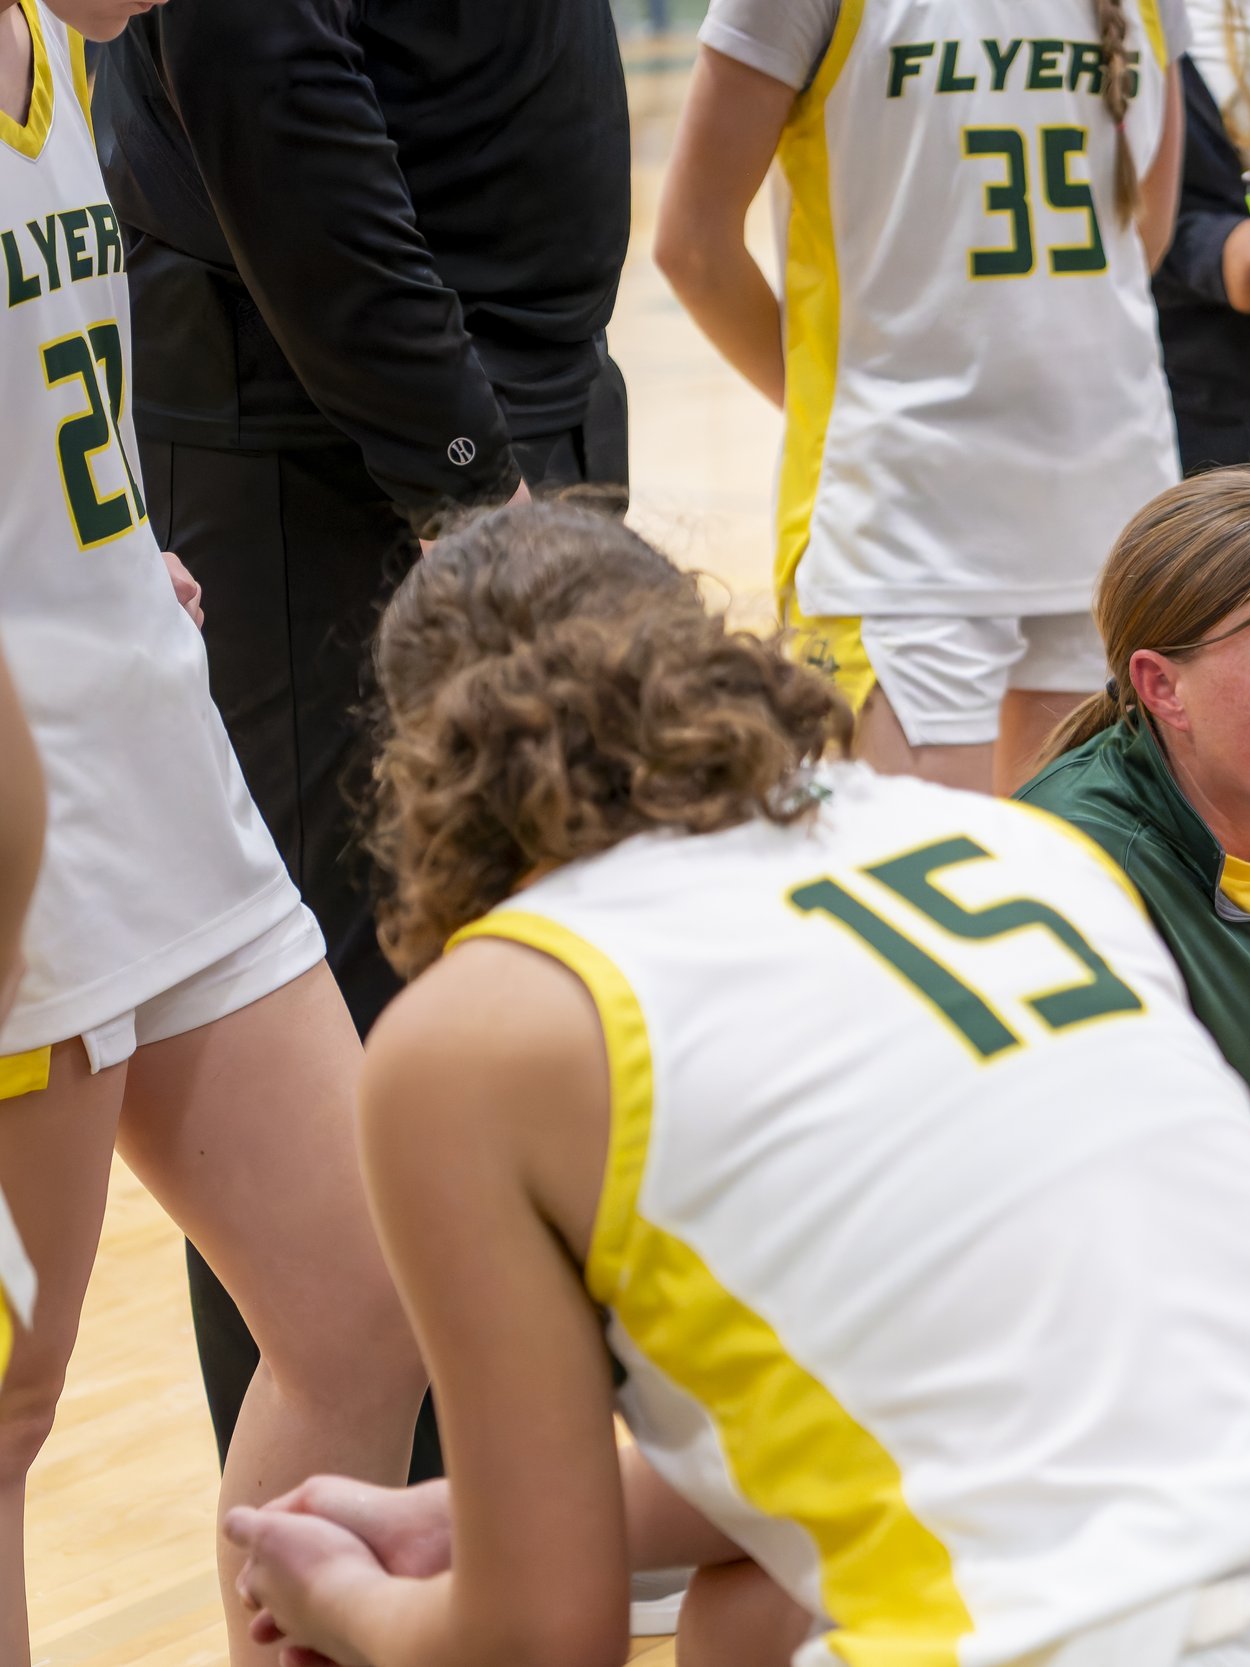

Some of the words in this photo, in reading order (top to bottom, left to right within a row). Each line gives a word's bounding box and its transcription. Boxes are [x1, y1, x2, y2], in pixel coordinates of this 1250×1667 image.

[0, 202, 128, 312] LYER
[961, 123, 1109, 280] 35
[785, 834, 1147, 1066] 15
